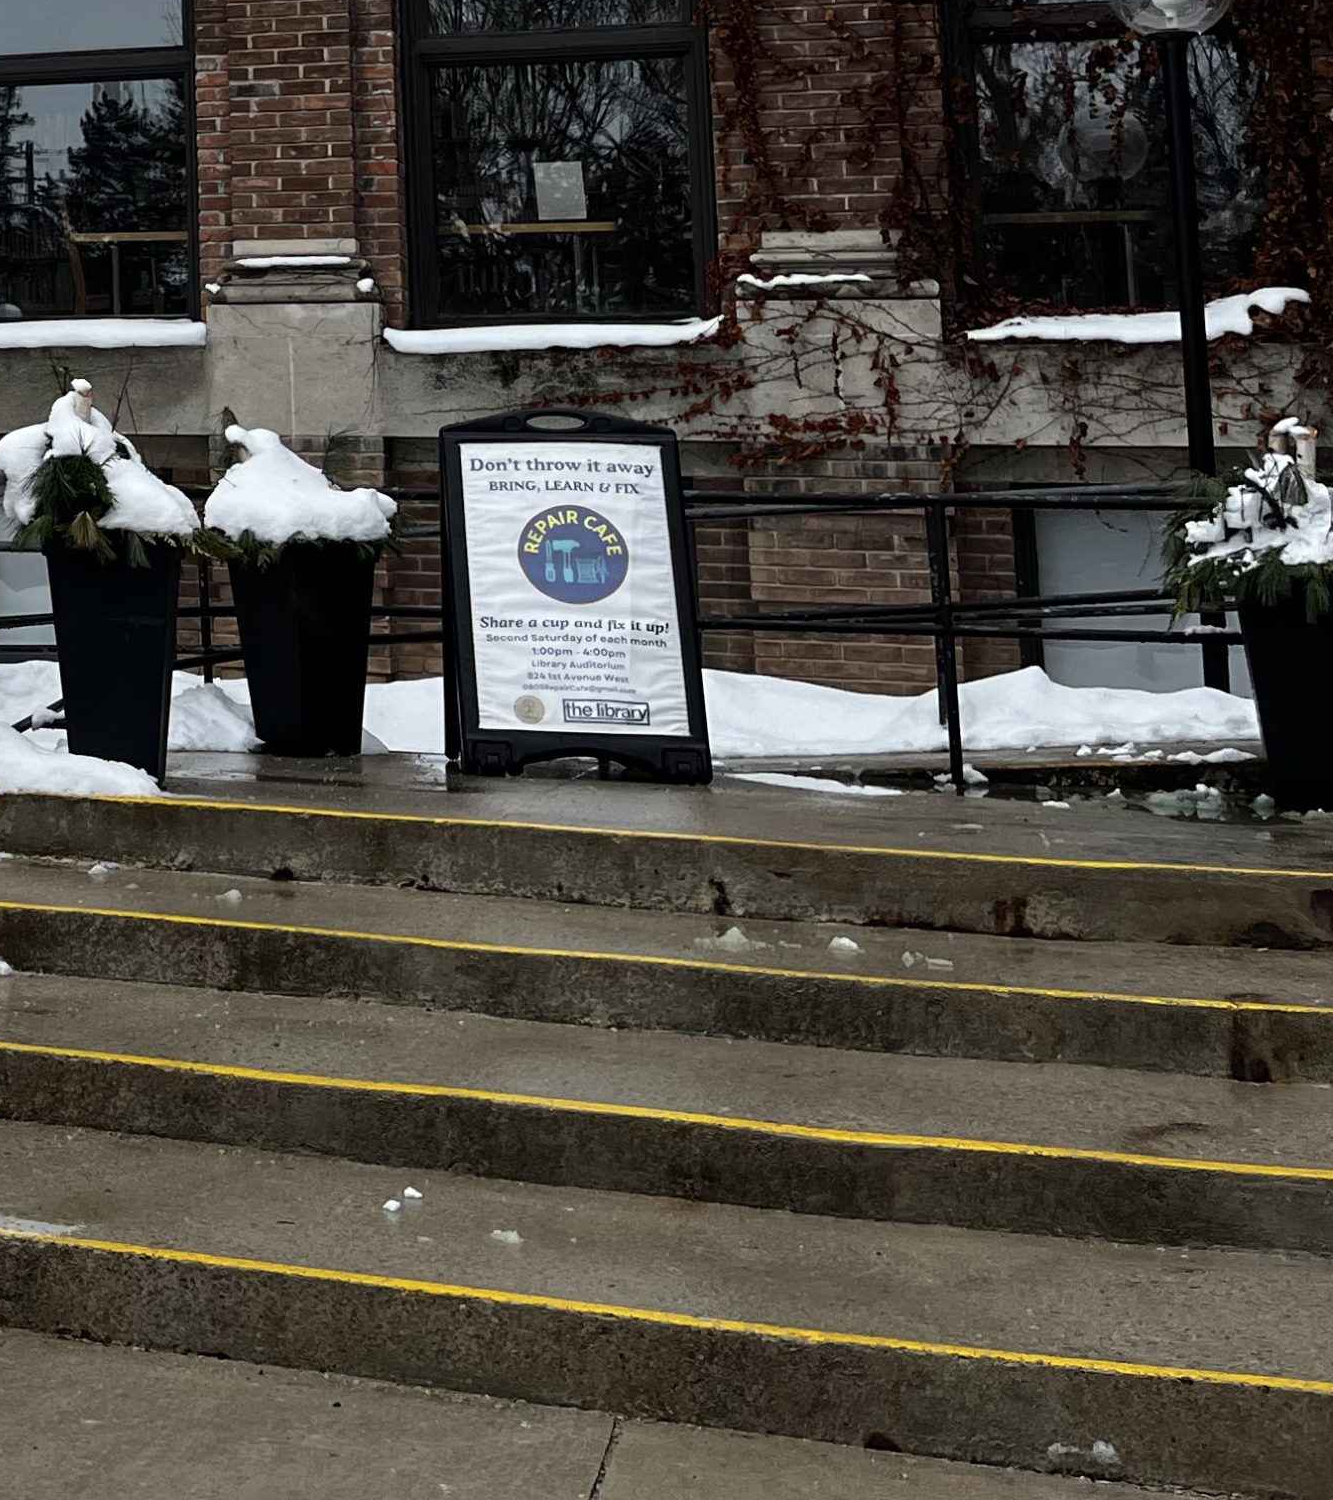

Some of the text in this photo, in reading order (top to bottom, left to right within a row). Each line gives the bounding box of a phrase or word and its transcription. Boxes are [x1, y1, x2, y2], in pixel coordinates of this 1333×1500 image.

[470, 458, 654, 477] Don't throw it away
[489, 481, 640, 494] BRING, LEARN & FIX
[523, 510, 623, 556] REPAIR CAFE
[480, 616, 669, 635] Share a cup and fix it up!
[486, 633, 667, 648] Second Saturday of each month
[531, 647, 573, 657] 1:00pm
[582, 647, 626, 658] 4:00pm
[531, 660, 625, 670] Library Auditorium
[547, 672, 561, 680] 1st
[564, 673, 602, 681] Avenue
[604, 674, 629, 683] West
[566, 702, 647, 721] the library
